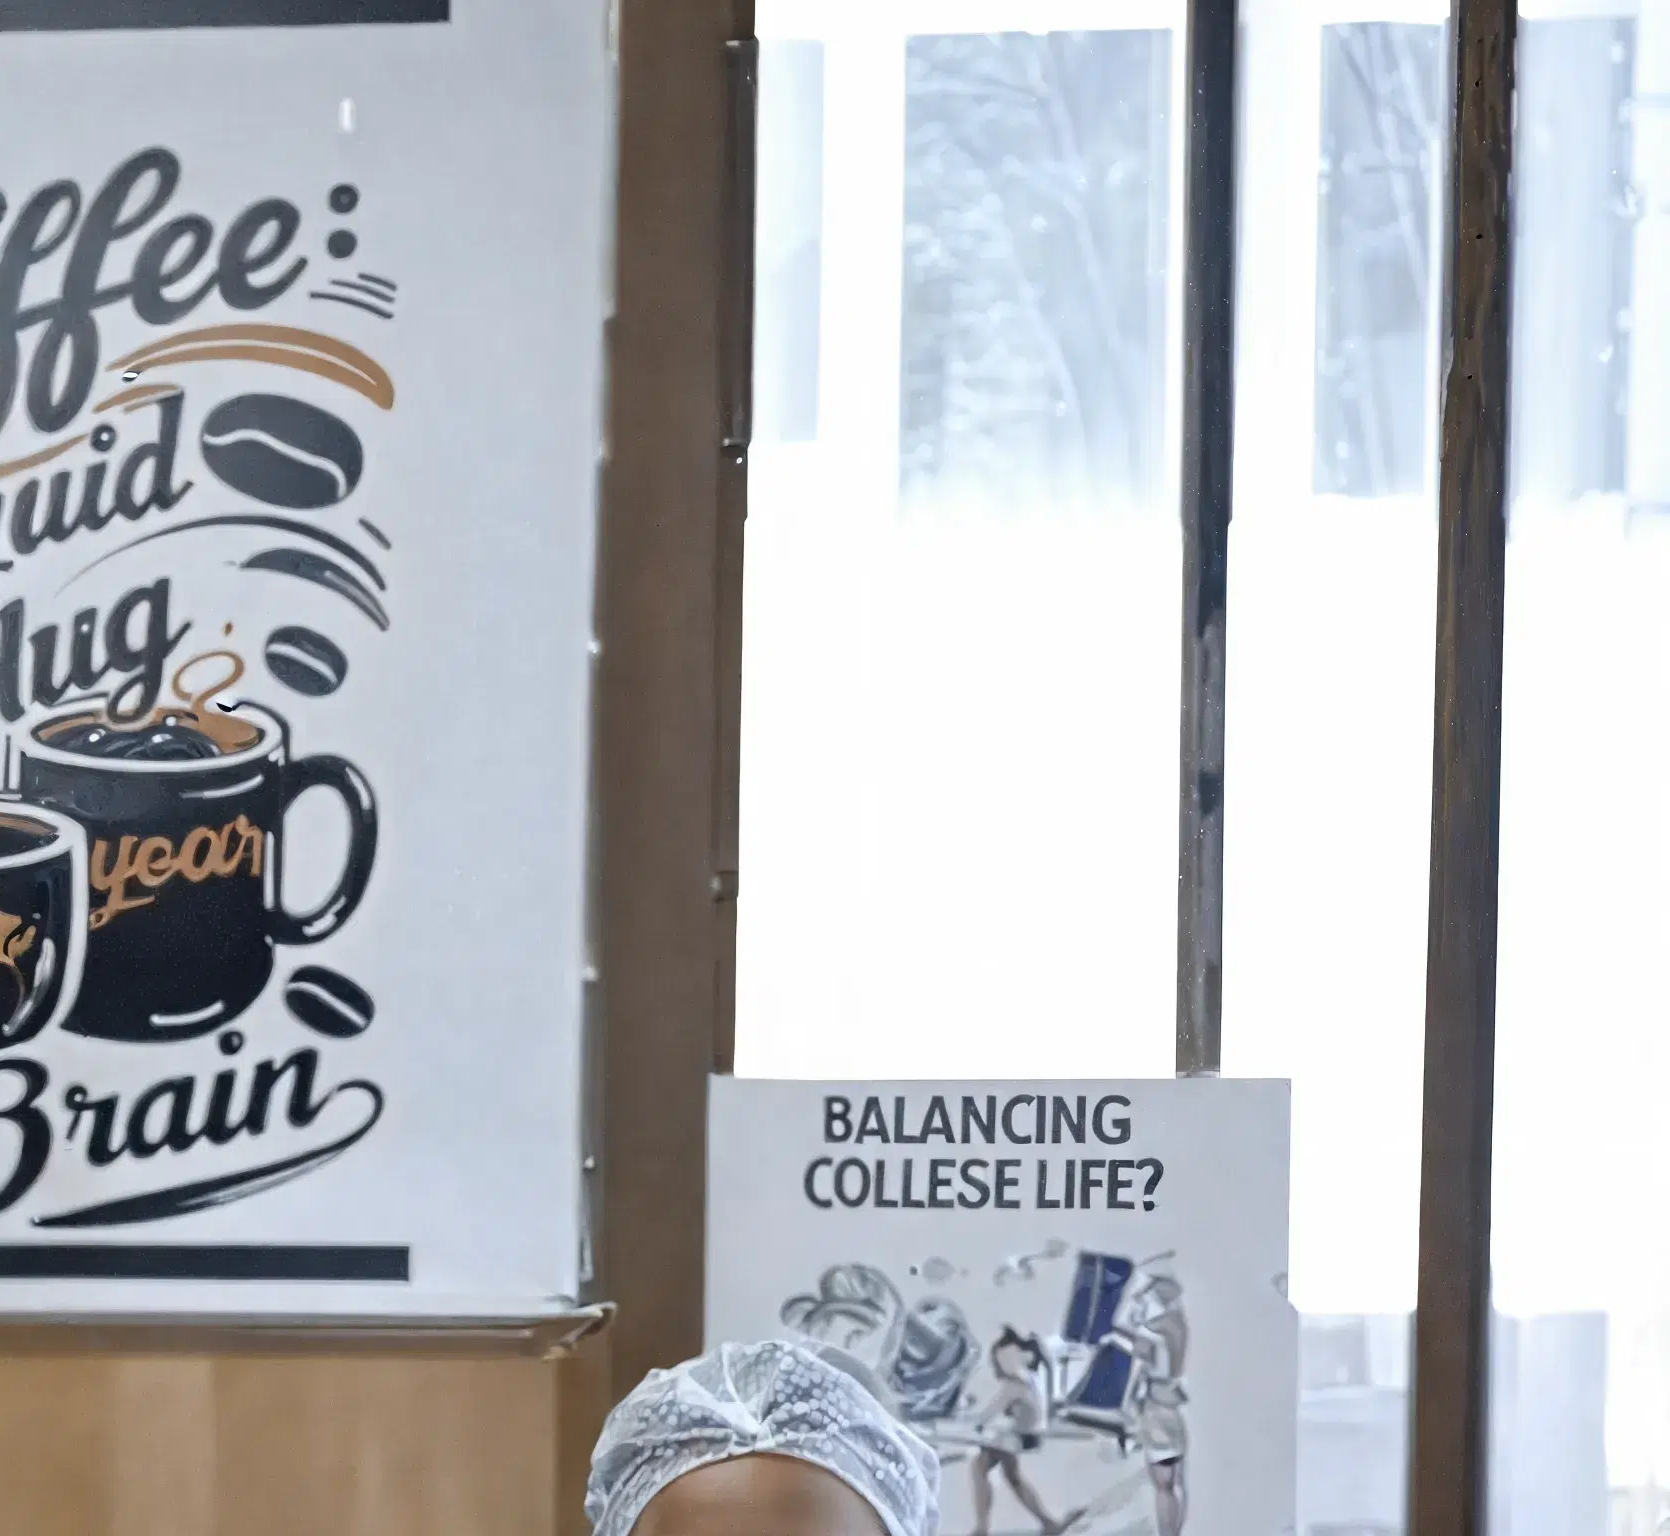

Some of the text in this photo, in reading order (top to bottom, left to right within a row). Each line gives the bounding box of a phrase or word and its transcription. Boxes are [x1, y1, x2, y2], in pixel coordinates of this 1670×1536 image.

[823, 1094, 1132, 1145] BALANCING
[803, 1156, 1165, 1212] COLLESE LIFE?
